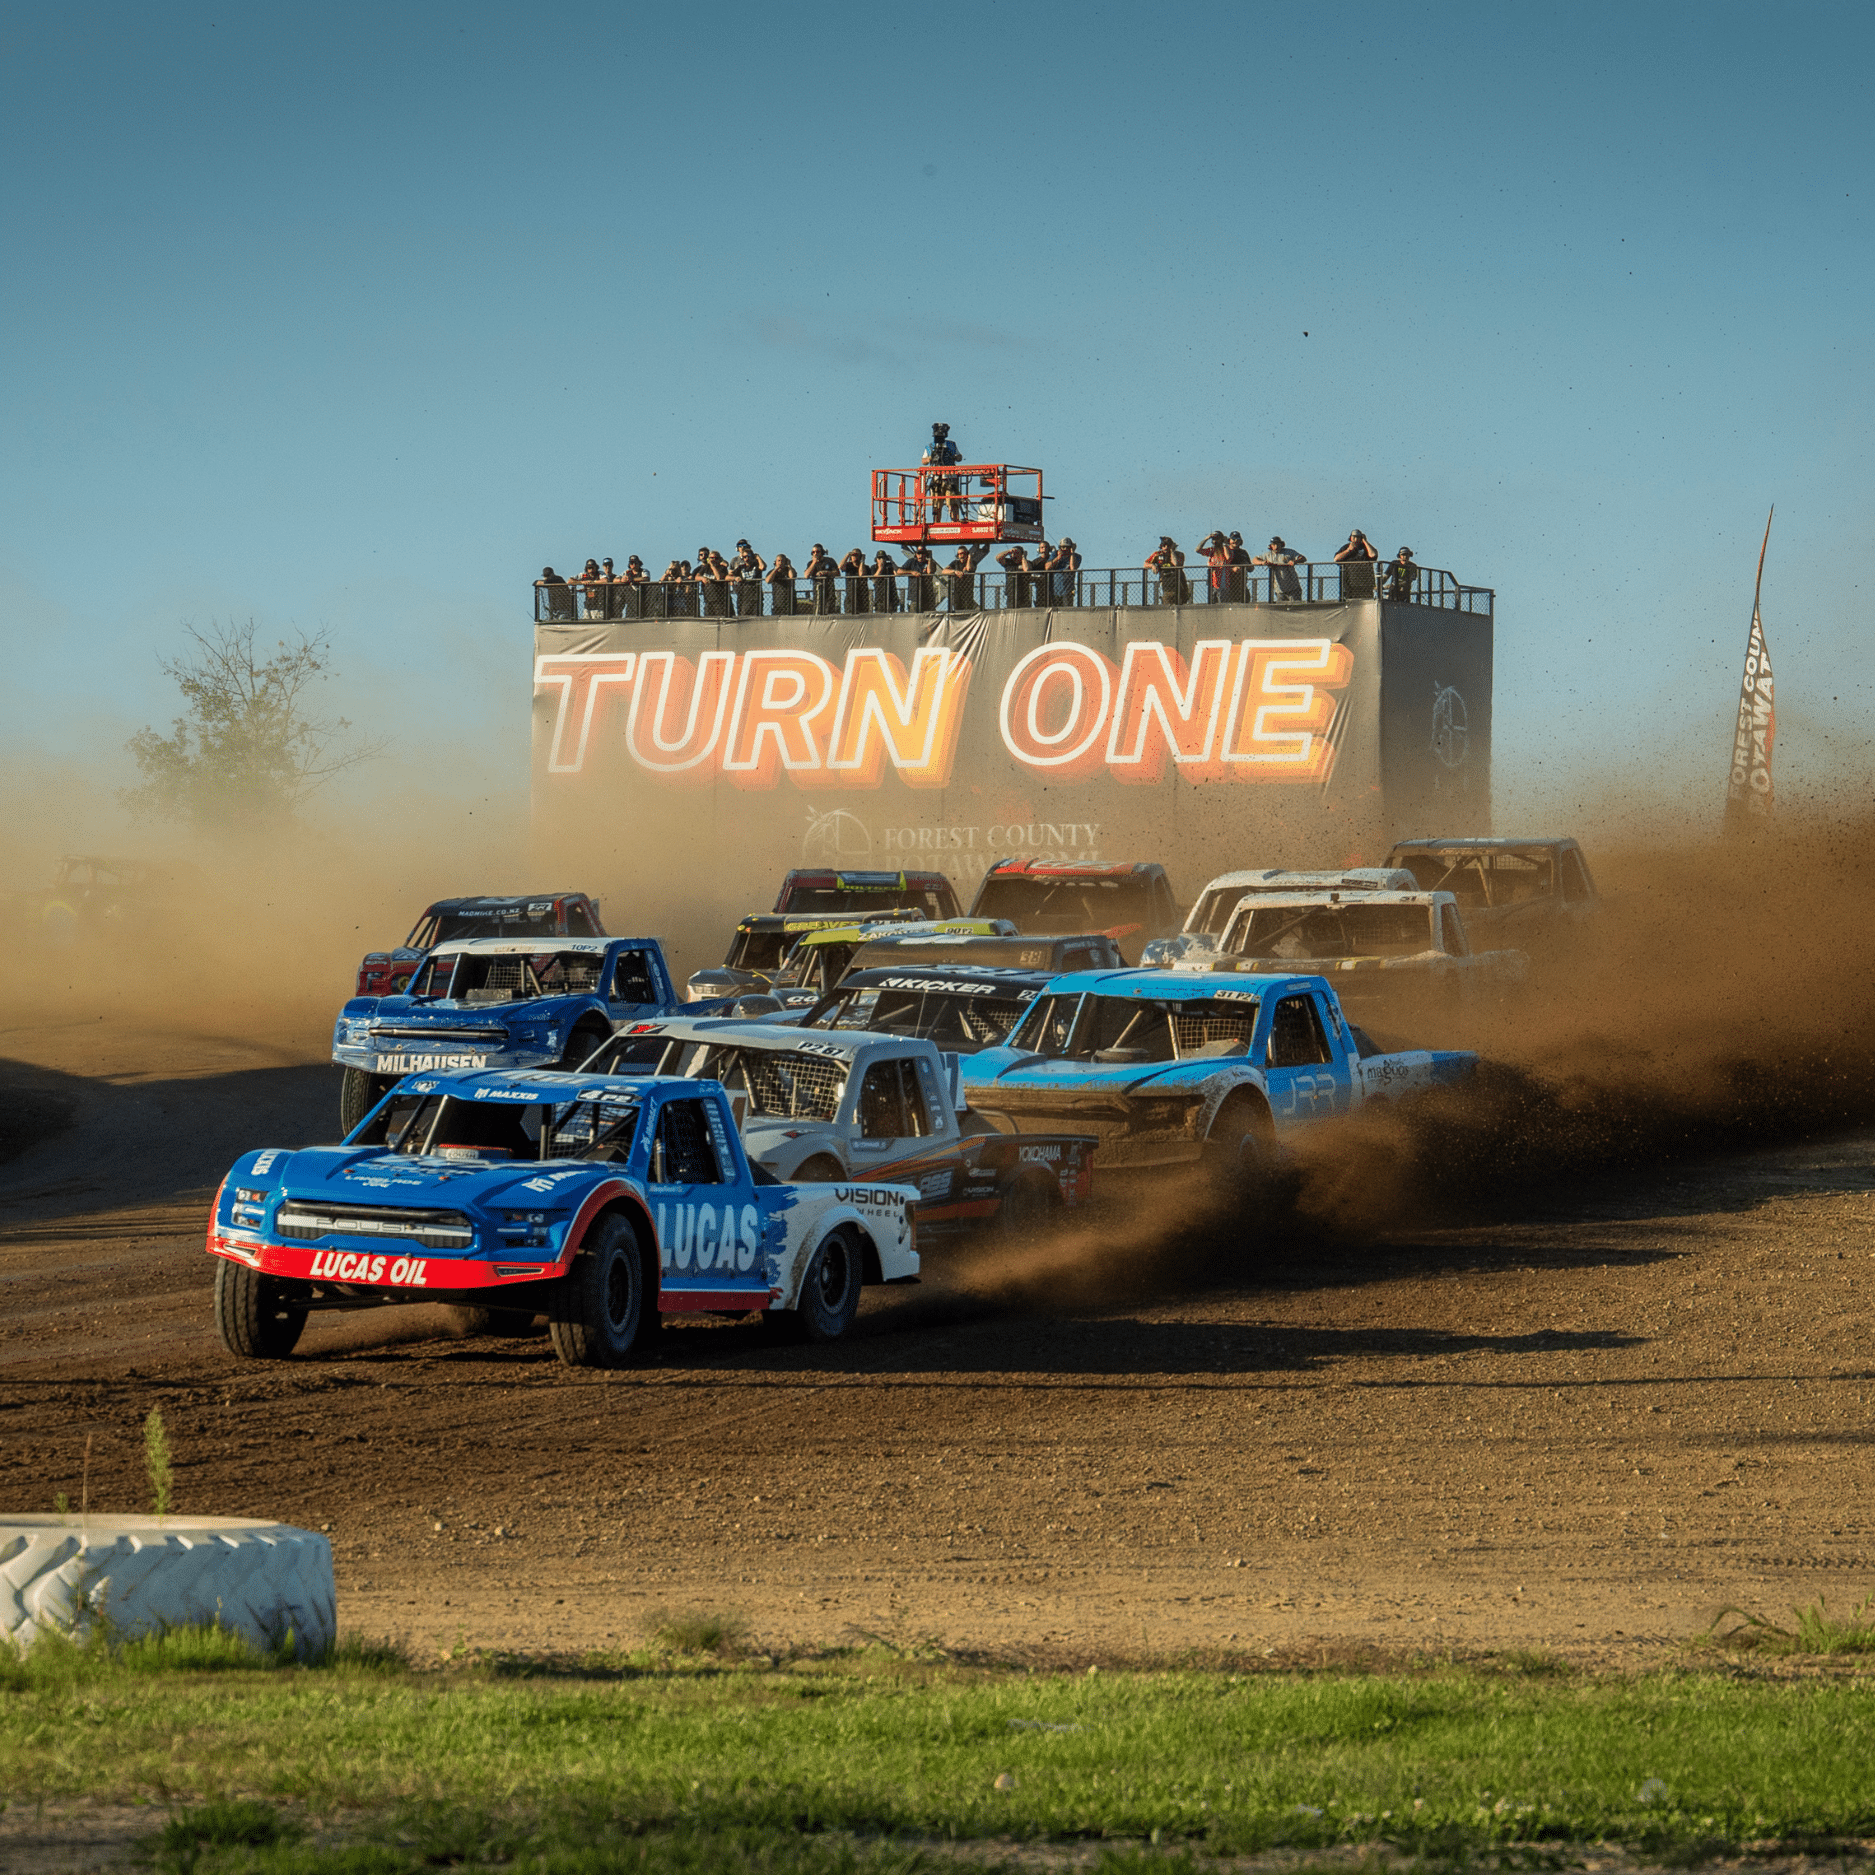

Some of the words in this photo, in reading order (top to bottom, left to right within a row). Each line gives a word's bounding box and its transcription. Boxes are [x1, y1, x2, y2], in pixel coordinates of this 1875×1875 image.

[533, 647, 953, 773] TURN
[999, 639, 1331, 766] ONE
[884, 826, 980, 850] FOREST
[986, 822, 1101, 849] COUNTY
[896, 978, 997, 994] KICKER
[488, 1090, 540, 1101] MAXXIS
[1018, 1145, 1062, 1162] YOKOHAMA
[834, 1187, 899, 1207] VISION
[857, 1207, 900, 1218] WHEEL
[657, 1202, 759, 1272] LUCAS
[309, 1251, 387, 1283] LUCAS
[389, 1257, 428, 1285] OIL
